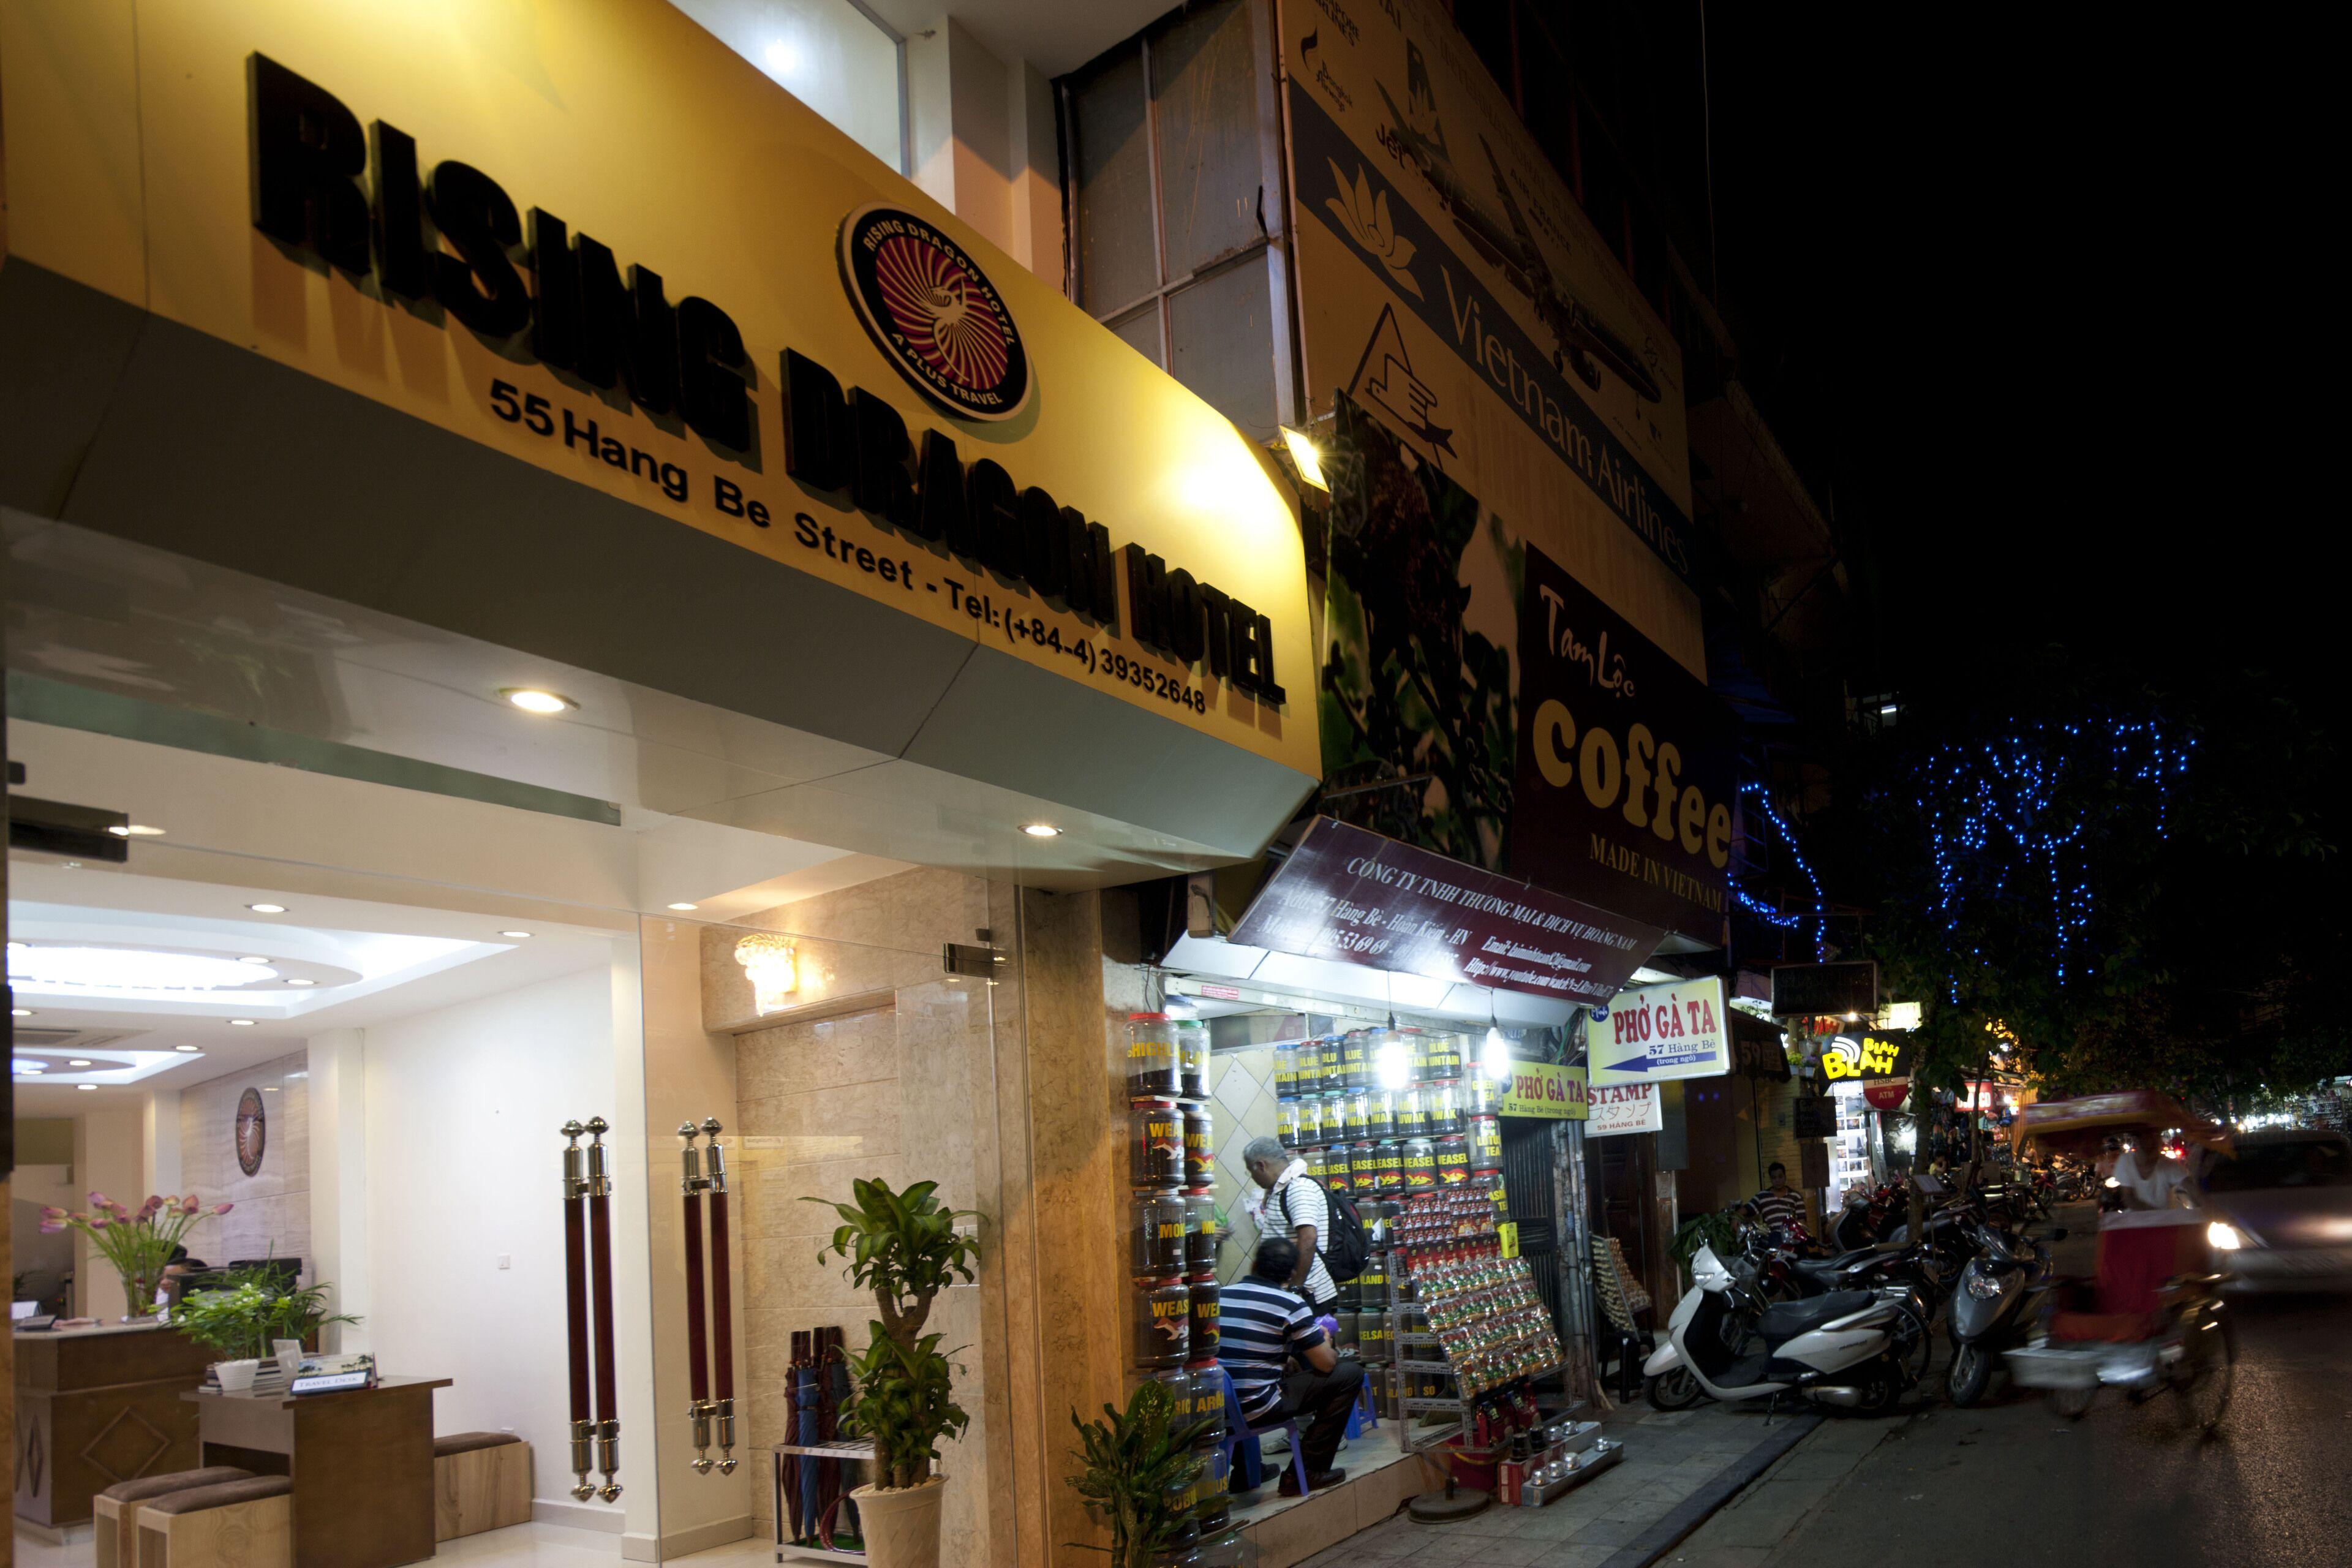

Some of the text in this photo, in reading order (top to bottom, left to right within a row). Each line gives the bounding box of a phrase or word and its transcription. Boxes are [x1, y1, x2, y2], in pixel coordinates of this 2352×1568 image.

[863, 220, 1016, 345] RISING DRAGON HOTEL
[246, 50, 1286, 705] RISING DRAGON HOTEL
[892, 333, 1003, 405] A PLUS TRAVEL
[1441, 265, 1594, 480] Vietnam
[1597, 445, 1690, 576] Airlines
[491, 379, 554, 437] 55
[562, 408, 688, 503] Hang
[714, 475, 771, 529] Be
[794, 513, 913, 591] Street
[1100, 647, 1206, 715] 39352648
[1590, 833, 1722, 913] MADE IN VIETNAM
[1330, 899, 1366, 927] Hàng
[1363, 907, 1385, 927] Bè
[1385, 913, 1417, 936] Hoàn
[1448, 928, 1473, 946] HN
[1347, 856, 1398, 884] CÔNG
[1395, 871, 1419, 891] TY
[1417, 878, 1458, 902] TNHH
[1532, 911, 1544, 926] &
[1613, 935, 1638, 952] NAM
[1613, 993, 1716, 1044] PHỞ GÀ TA
[1649, 1039, 1716, 1055] 57 Hàng Bè
[1656, 1057, 1679, 1066] (trong
[1822, 1050, 1893, 1079] BLAH
[1863, 1038, 1900, 1057] BLAH
[1508, 1103, 1517, 1112] 57
[1515, 1068, 1585, 1103] PHỞ GÀ TA
[1588, 1083, 1652, 1106] STAMP
[1879, 1091, 1894, 1099] ATM
